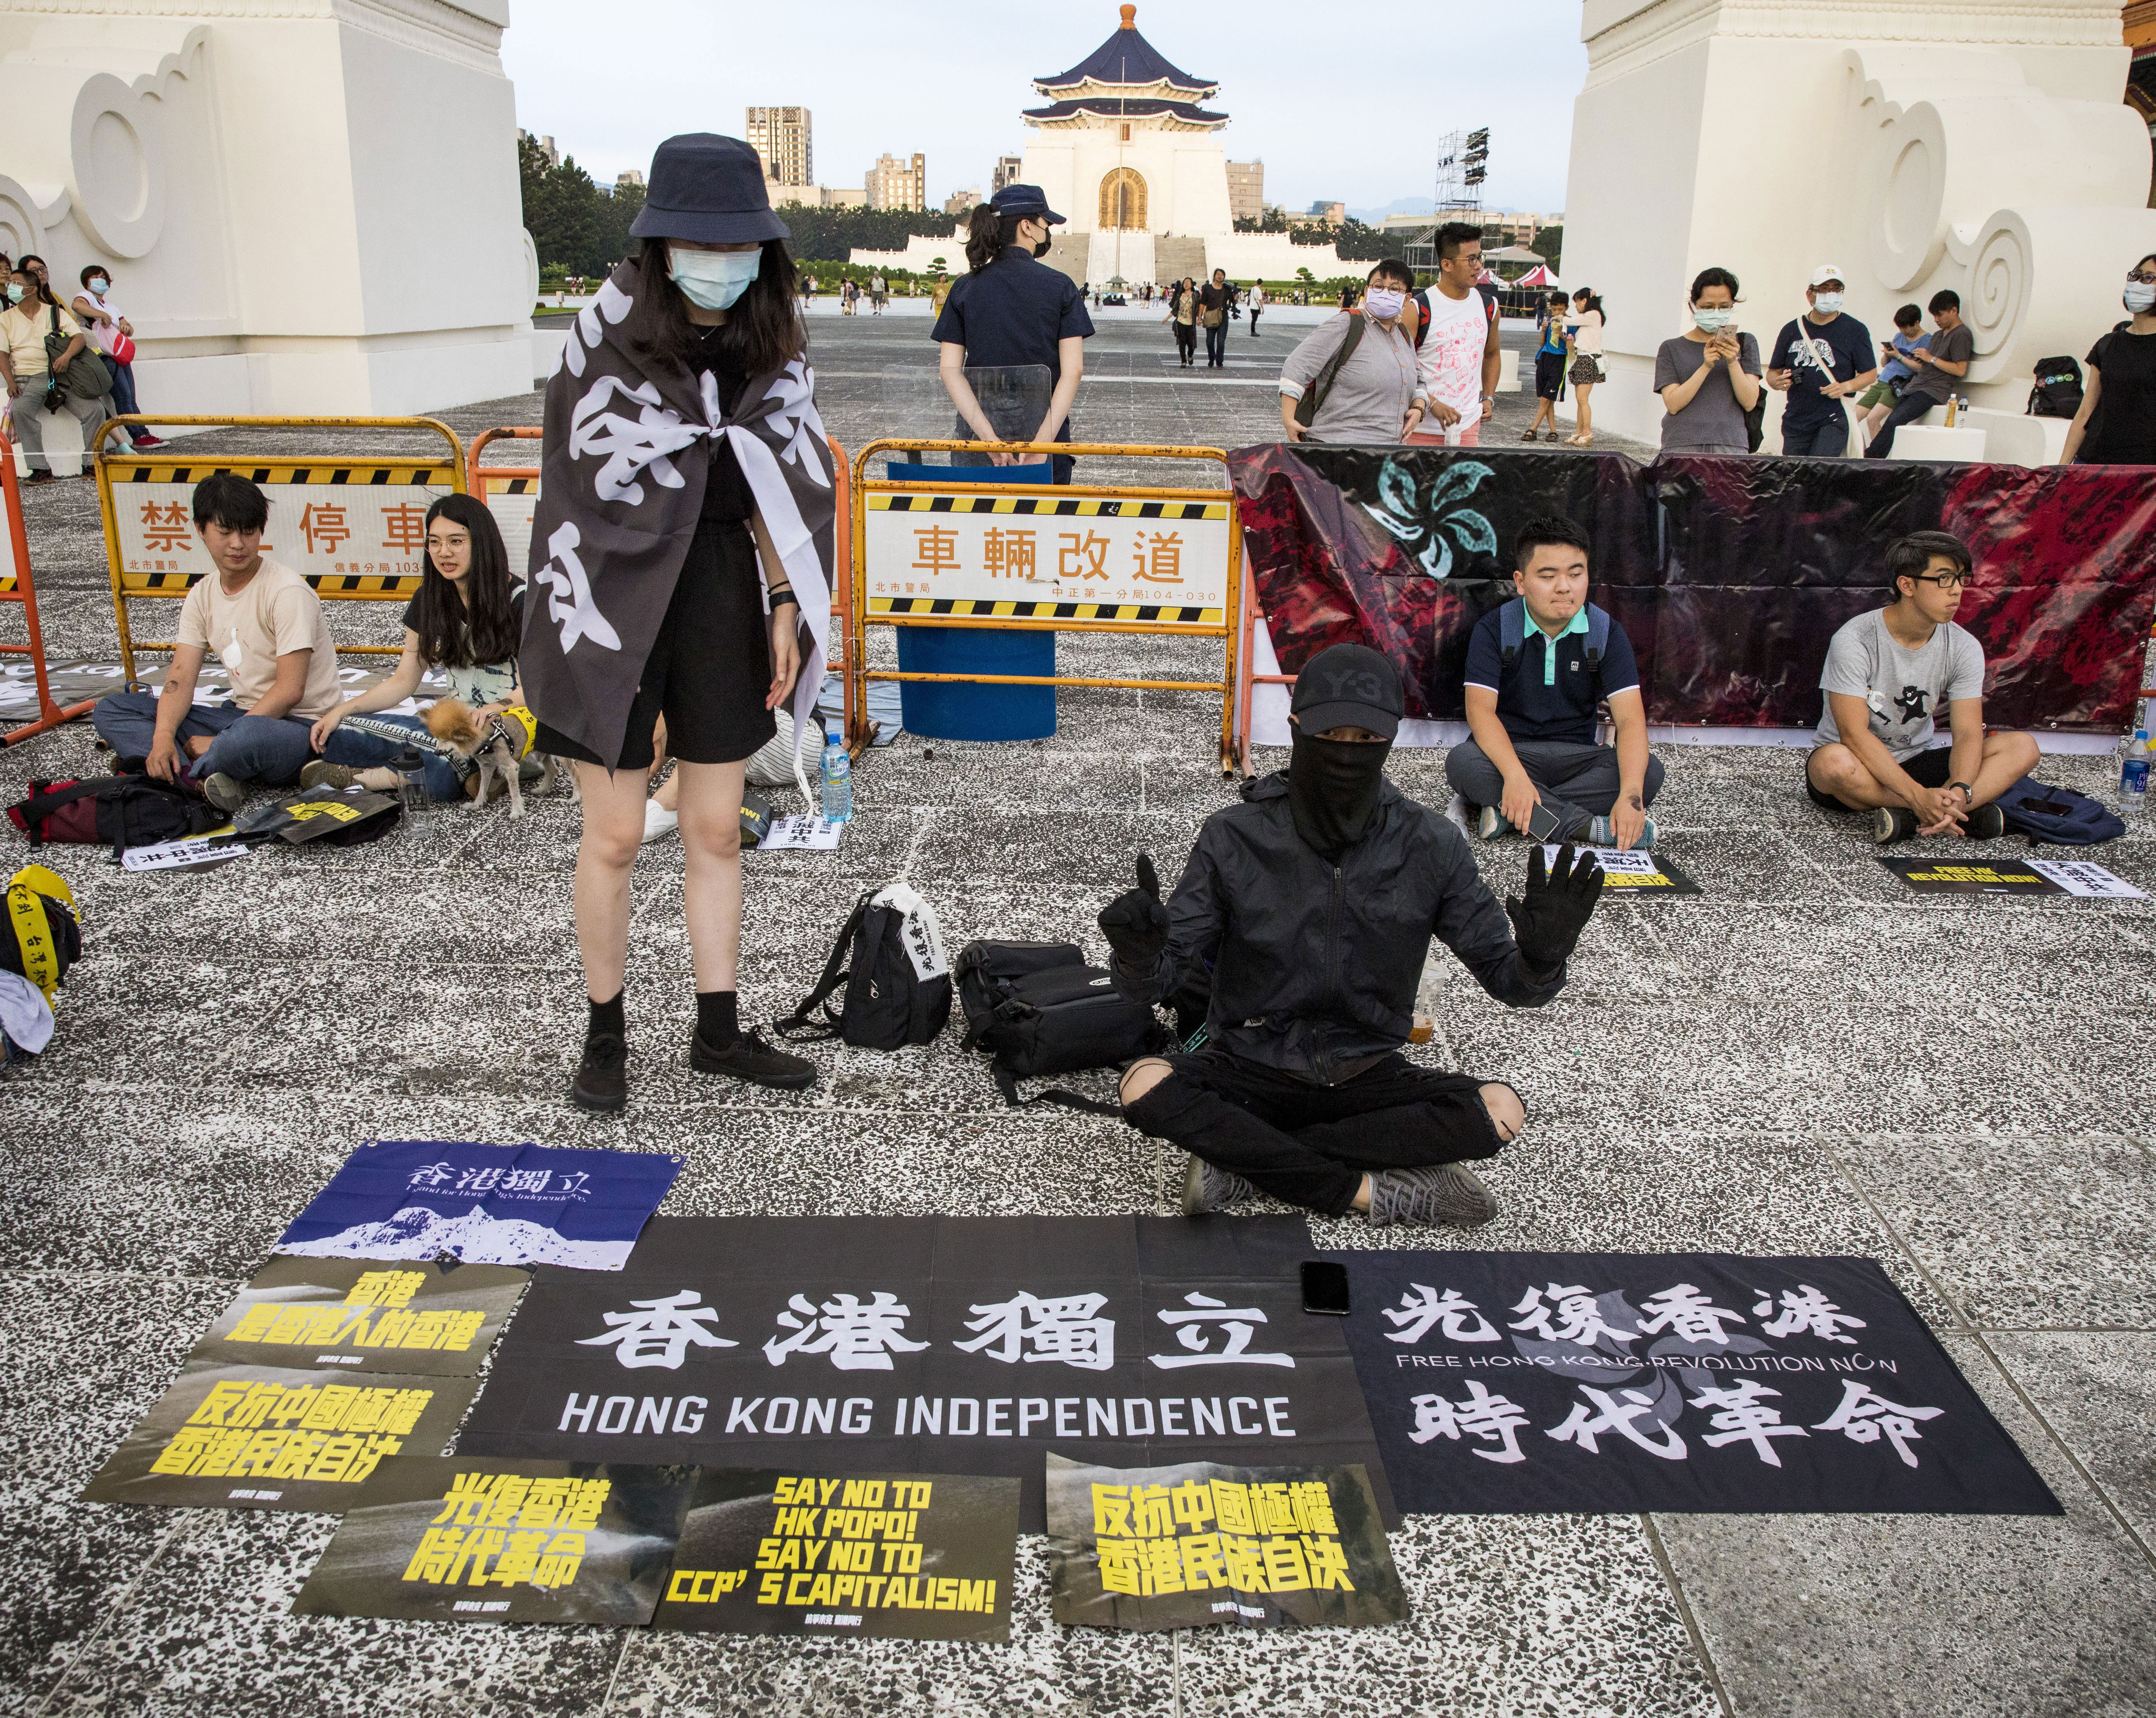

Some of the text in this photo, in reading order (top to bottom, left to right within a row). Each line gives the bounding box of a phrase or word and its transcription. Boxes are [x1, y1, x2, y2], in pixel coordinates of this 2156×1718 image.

[140, 501, 427, 555] 禁停車
[130, 560, 178, 571] 北市警局
[911, 525, 1184, 583] 車輛改道
[875, 582, 931, 594] 北市警局
[1906, 873, 2043, 883] REVOLUTION NOW!
[1933, 866, 1975, 874] FREE
[2049, 862, 2112, 892] 天滅中共
[908, 910, 935, 972] 光復香港
[407, 1162, 591, 1194] 香港獨立
[343, 1270, 427, 1308] 香港
[224, 1303, 486, 1351] 是香港人的香港
[574, 1289, 1296, 1371] 香港獨立
[1381, 1282, 1867, 1346] 光復香港
[1396, 1355, 1463, 1367] FREE
[1469, 1355, 1556, 1368] HONG
[185, 1381, 434, 1435] 反抗中國極權
[557, 1392, 1296, 1437] HONG KONG INDEPENDENCE
[1408, 1378, 1945, 1468] 時代革命
[428, 1472, 612, 1531] 光復香港
[772, 1477, 932, 1510] SAY NO TO
[1091, 1478, 1339, 1538] 反抗中國極權
[773, 1508, 918, 1542] HK POPO!
[402, 1527, 587, 1589] 時代革命
[755, 1538, 924, 1574] SAY NO TO
[1096, 1532, 1355, 1596] 香港民族自決
[785, 1574, 997, 1614] CAPITALISM!
